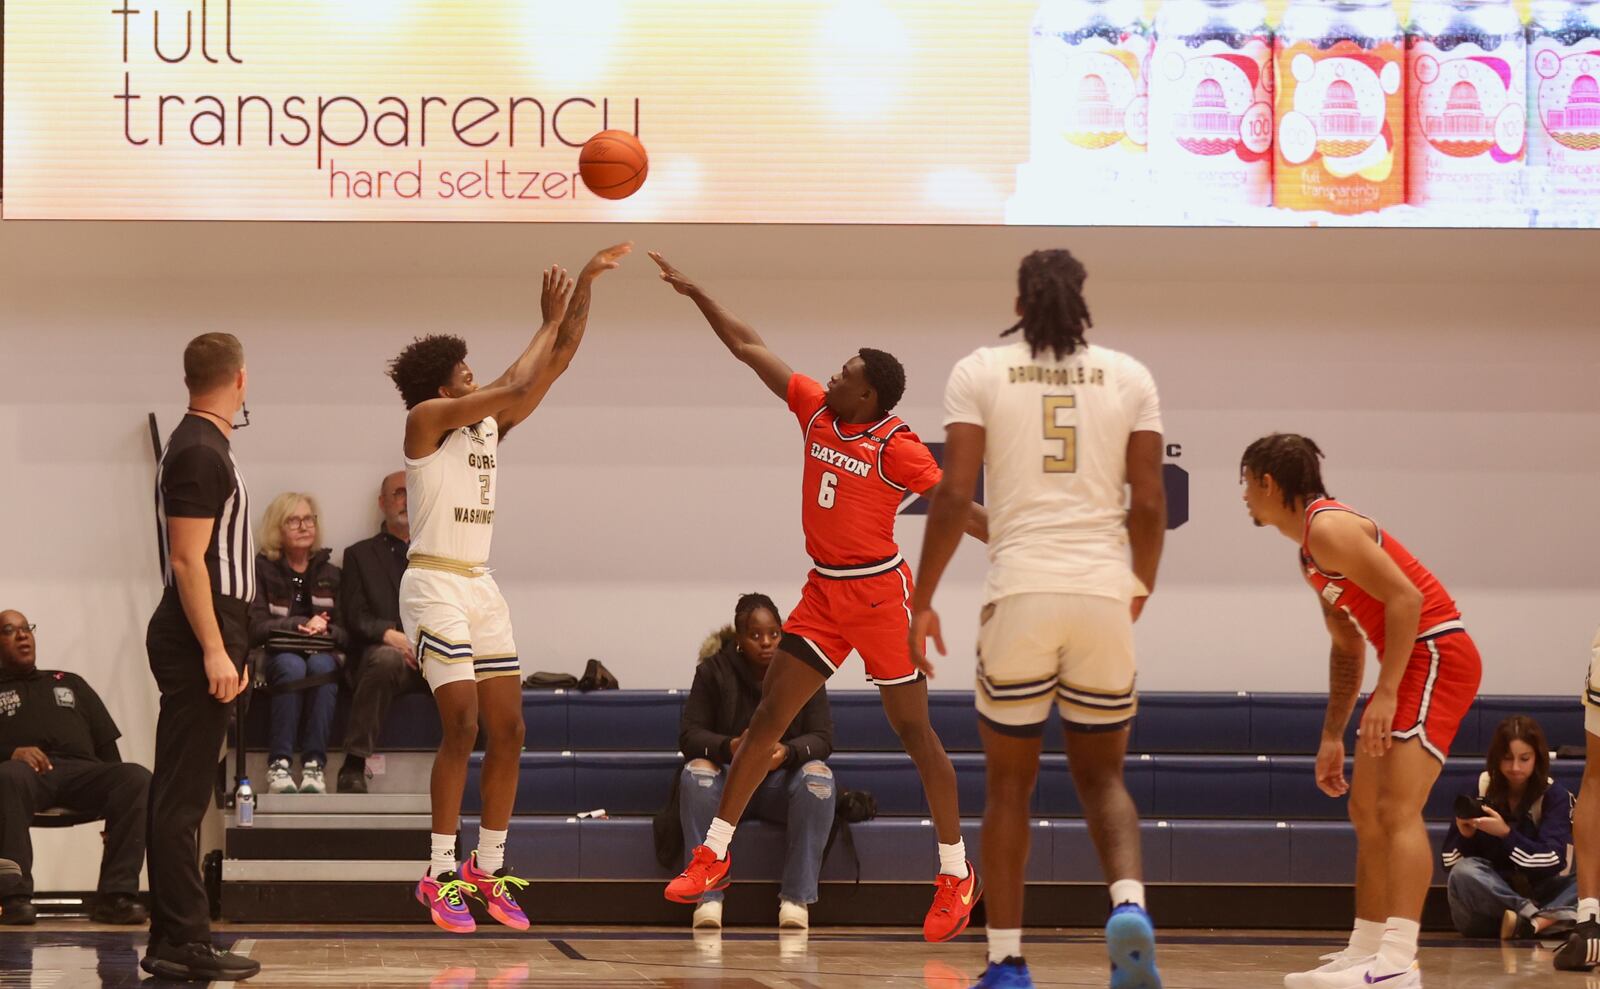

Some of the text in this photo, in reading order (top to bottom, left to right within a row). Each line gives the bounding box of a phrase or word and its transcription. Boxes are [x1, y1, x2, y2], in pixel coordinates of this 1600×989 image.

[112, 0, 243, 63] full
[1248, 118, 1270, 137] 100
[329, 160, 581, 199] hard seltzer
[1090, 367, 1105, 386] JR
[1041, 394, 1077, 474] 5
[810, 442, 873, 478] DAYTON
[478, 474, 491, 505] 2
[817, 471, 839, 510] 6
